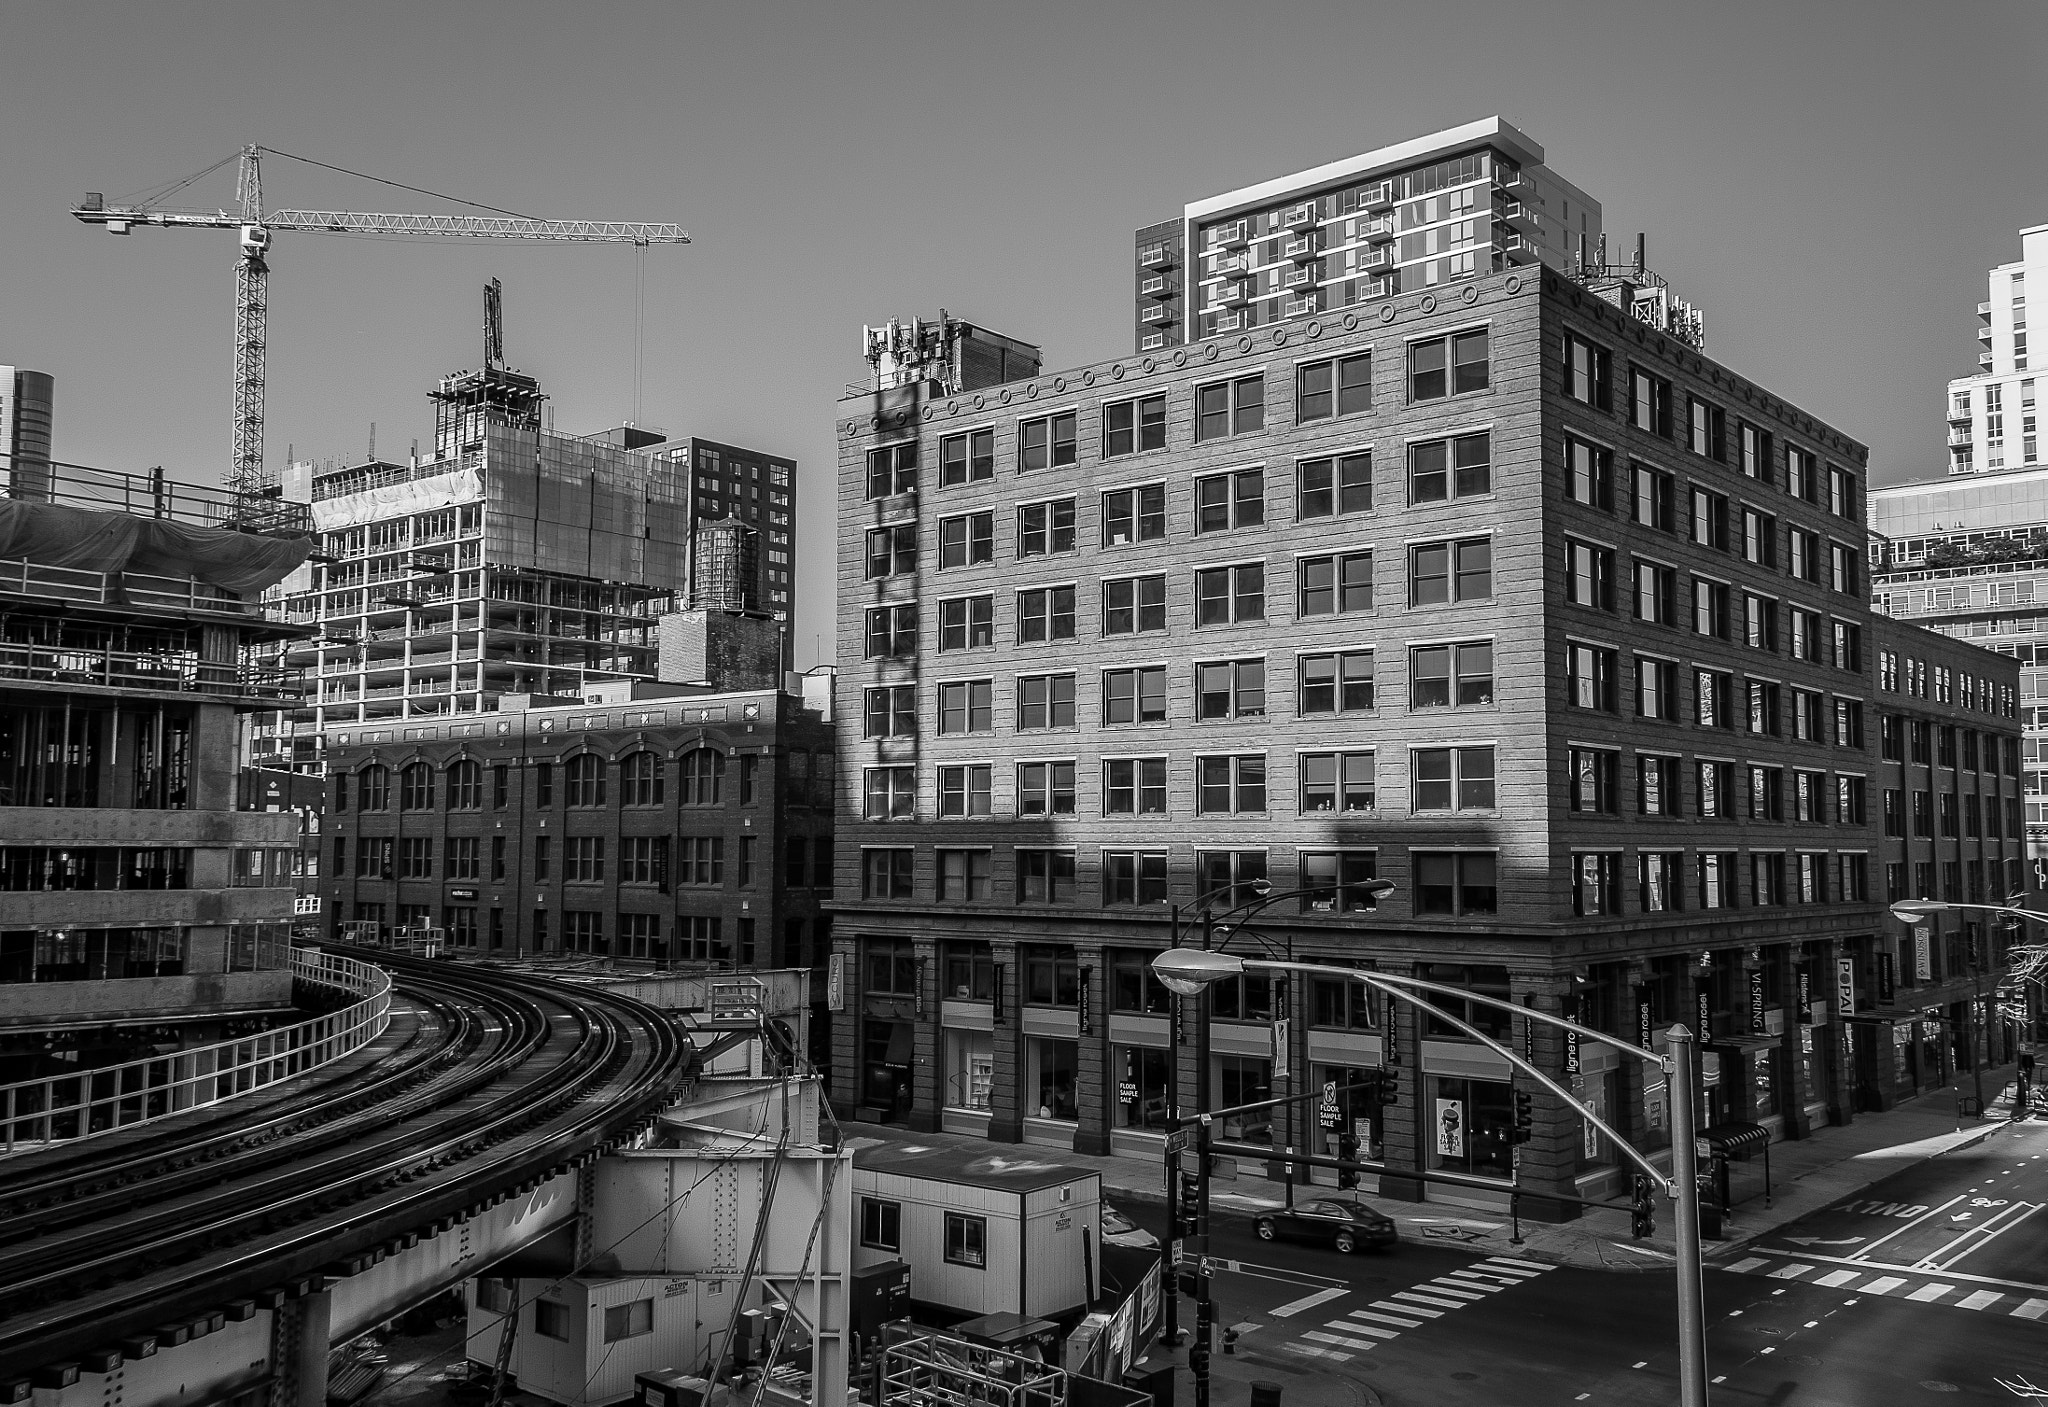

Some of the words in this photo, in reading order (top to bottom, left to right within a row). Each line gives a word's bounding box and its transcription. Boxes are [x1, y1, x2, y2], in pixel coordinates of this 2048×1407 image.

[1699, 992, 1708, 1018] roset
[1640, 1002, 1649, 1030] roset
[1567, 1014, 1576, 1044] roet
[1700, 1019, 1710, 1043] ligne
[1566, 1044, 1578, 1072] ligne
[1119, 1082, 1136, 1091] FLOOR
[1119, 1089, 1139, 1098] SAMPLE
[1119, 1096, 1133, 1104] SALE
[1320, 1104, 1340, 1113] FLOOR
[1320, 1111, 1342, 1121] SAMPLE
[1320, 1119, 1335, 1128] SALE
[1832, 1200, 1929, 1218] ONLY
[664, 1281, 689, 1291] ACTON
